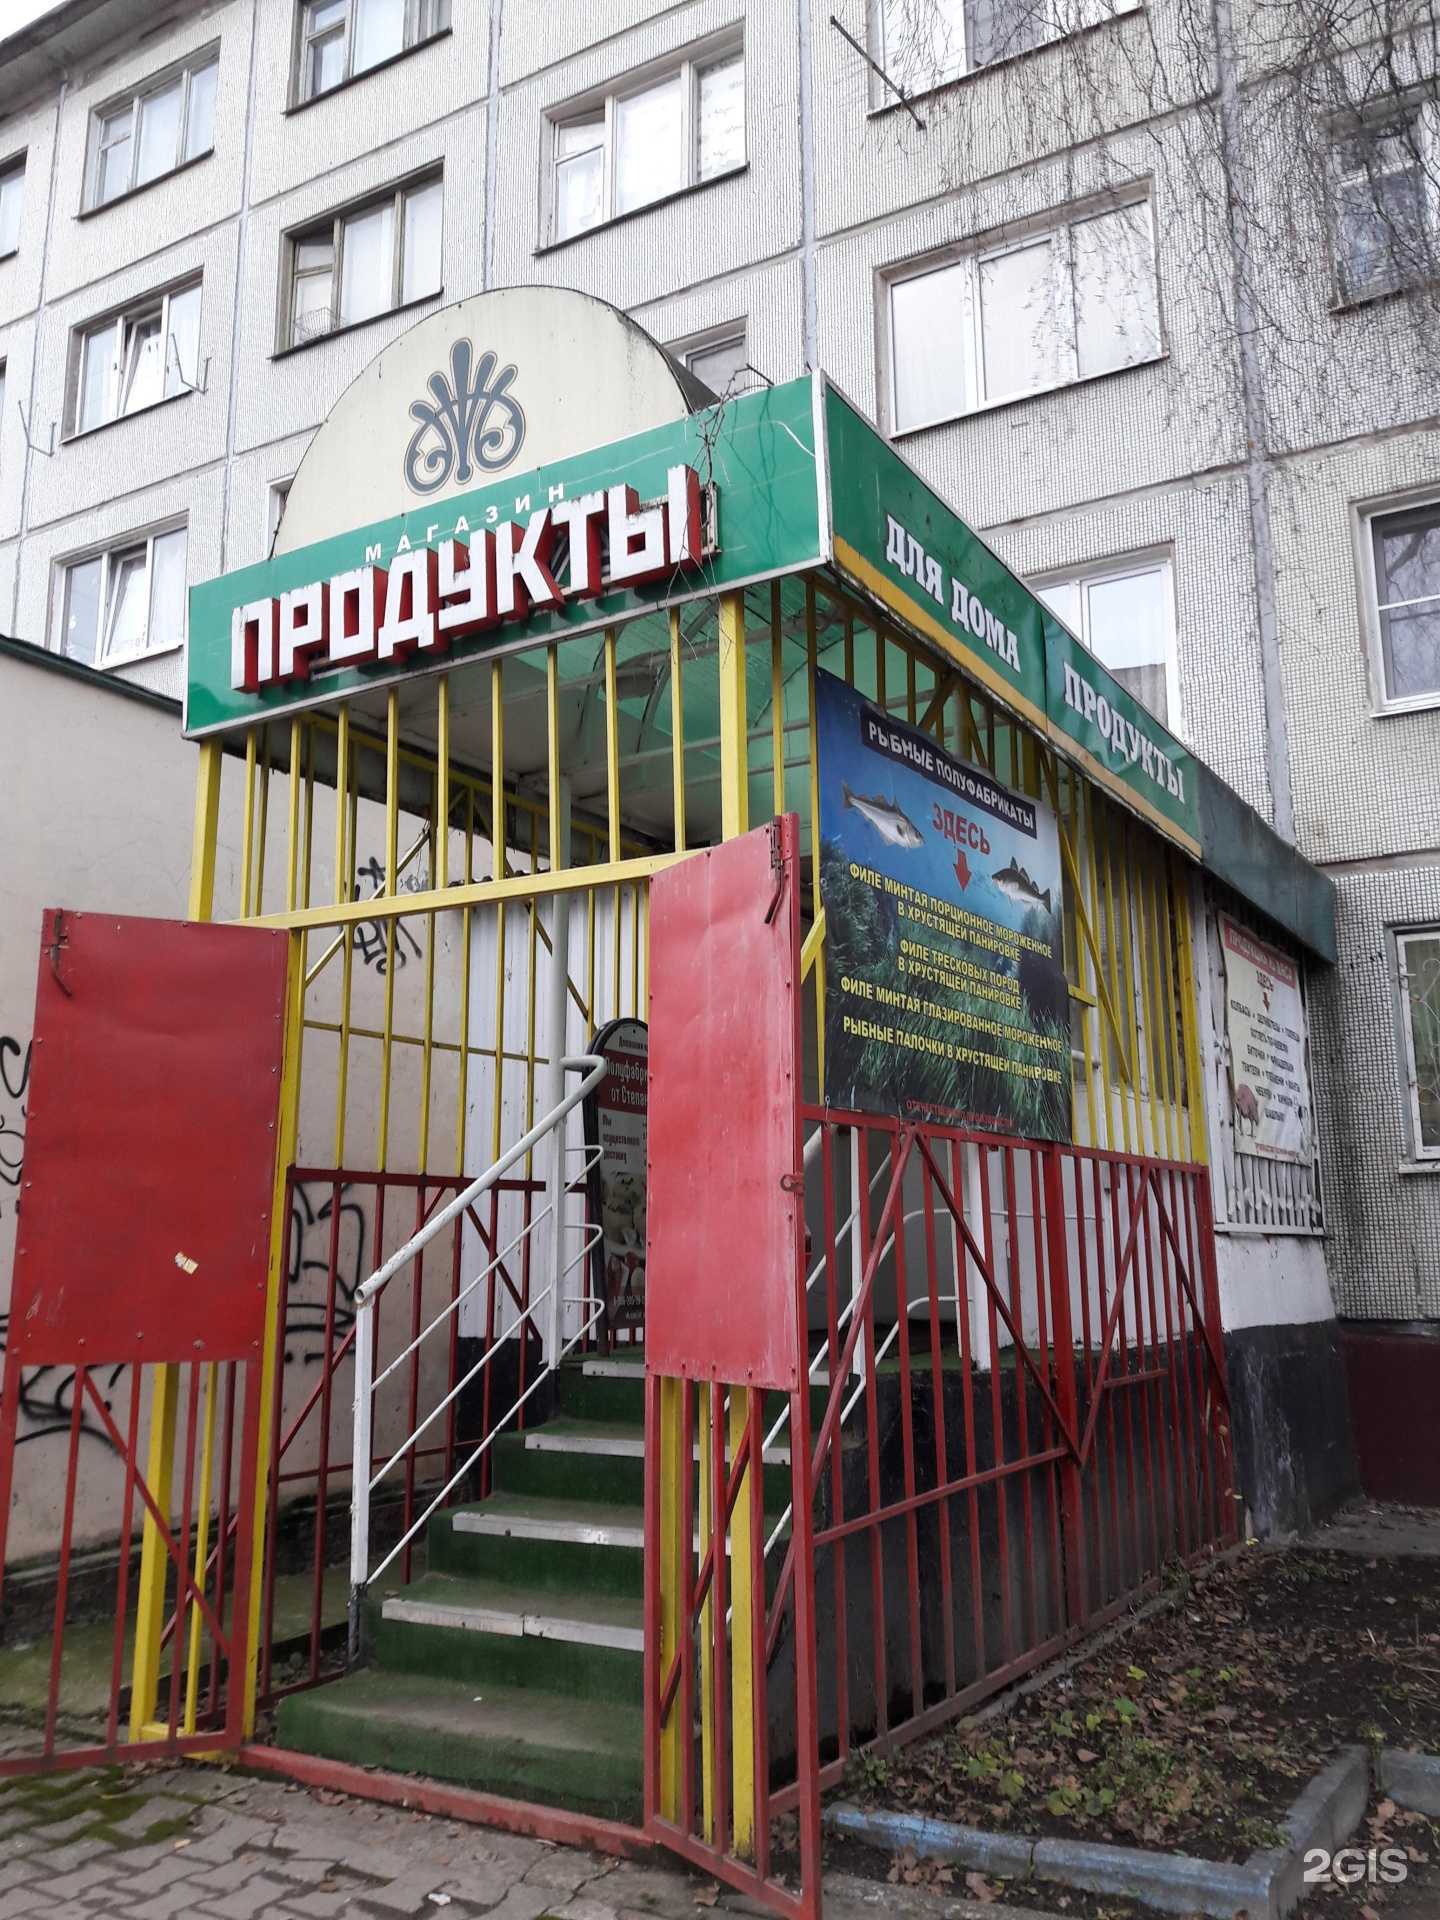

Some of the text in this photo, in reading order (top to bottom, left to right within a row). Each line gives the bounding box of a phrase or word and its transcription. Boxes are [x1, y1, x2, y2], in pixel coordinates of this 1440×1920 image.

[365, 482, 565, 562] МАГАЗИН
[230, 464, 702, 692] ПРОДУКТЫ
[886, 514, 1021, 673] ДЛЯ ДОМА
[1063, 662, 1185, 804] ПРОДУКТЫ
[868, 721, 1034, 829] РЫБНЫЕ ПОЛУФАБРИКАТЫ
[932, 802, 991, 856] ЗДЕСЬ
[850, 863, 1052, 958] ФИЛЕ МИНТАЯ ПОРЦИОННОЕ МОРОЖЕННОЕ
[897, 902, 1021, 961] В ХРУСТЯЩЕЙ ПАНИРОВКЕ
[898, 958, 1021, 1009] В ХРУСТЯЩЕЙ ПАНИРОВКЕ
[900, 939, 1020, 994] ФИЛЕ ТРЕСКОВЫХ ПОРОД
[841, 976, 1062, 1053] ФИЛЕ МИНТАЯ ГЛАЗИРОВАННОЕ МОРОЖЕННОЕ
[844, 1016, 1062, 1084] РЫБНЫЕ ПАЛОЧКИ В ХРУСТЯЩЕЙ ПАНИРОВКЕ
[621, 1085, 647, 1106] Степа
